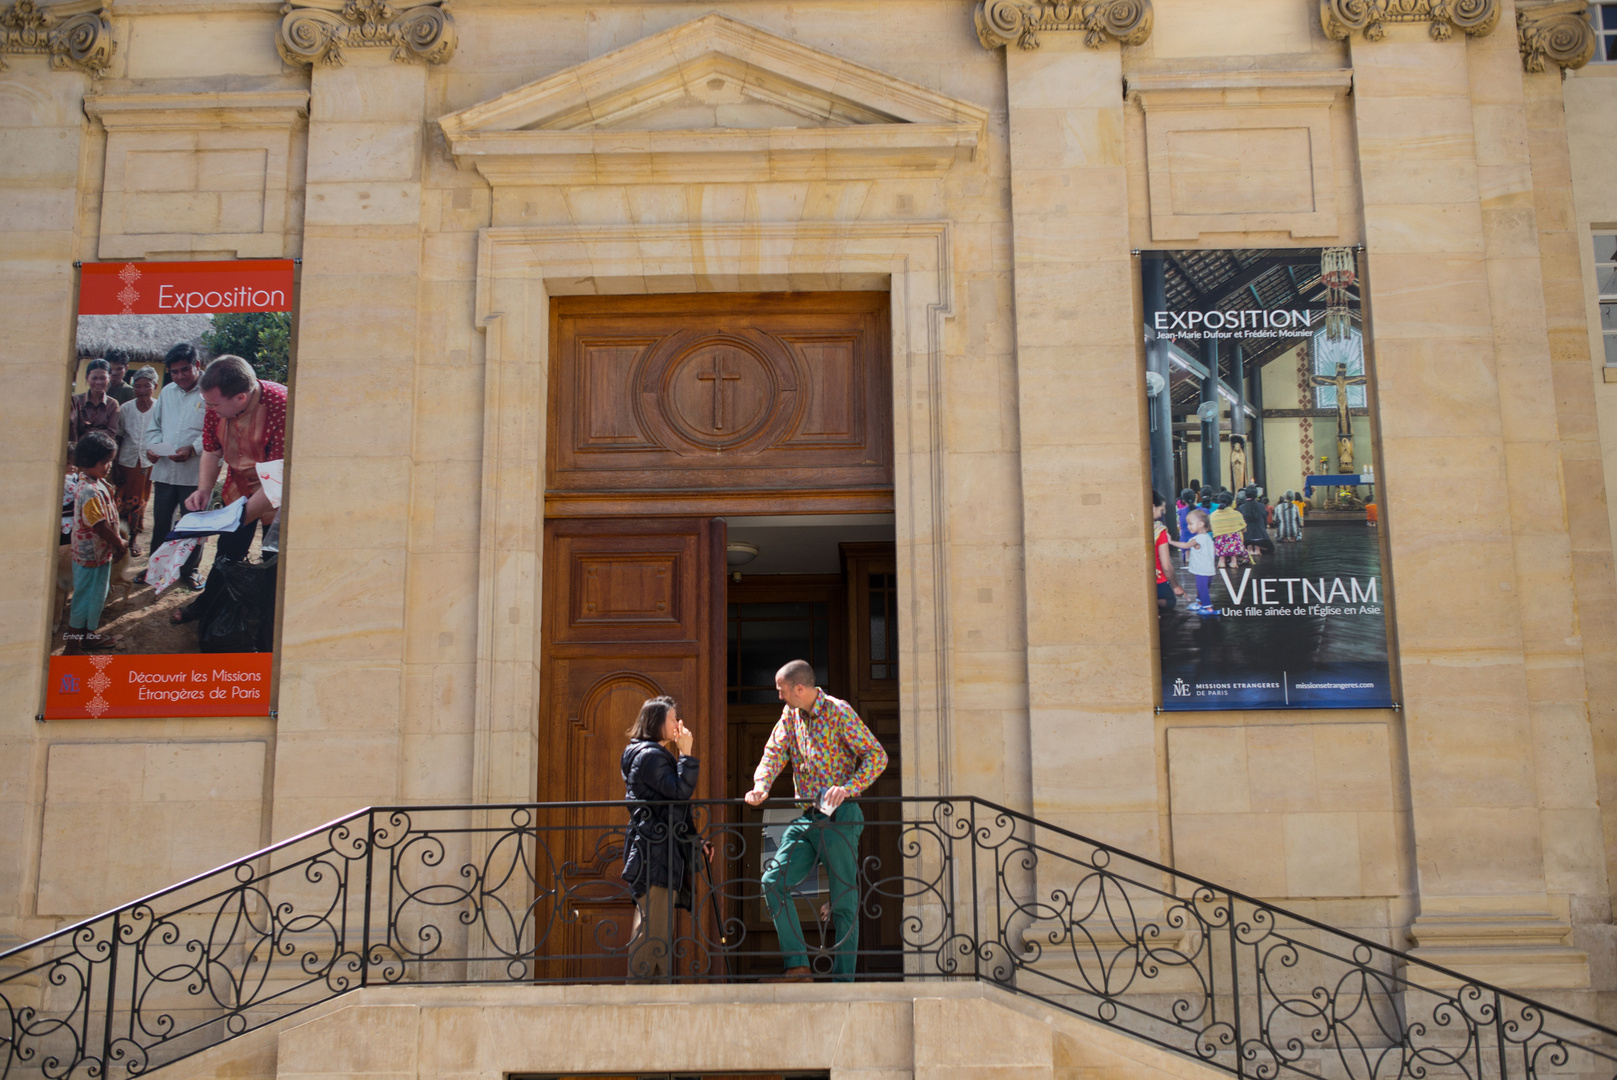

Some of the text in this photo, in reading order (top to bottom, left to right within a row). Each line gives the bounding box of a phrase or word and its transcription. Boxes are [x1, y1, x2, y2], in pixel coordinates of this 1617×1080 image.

[159, 284, 284, 313] Exposition
[1154, 309, 1311, 330] EXPOSITION
[1156, 329, 1313, 339] Jean-Marie Dufour et Frédéric Mounier
[1219, 568, 1378, 605] VIETNAM
[1221, 607, 1243, 617] Une
[1244, 606, 1263, 616] fille
[1264, 606, 1291, 616] aînée
[1293, 605, 1307, 616] de
[1344, 604, 1357, 615] en
[1358, 605, 1381, 615] Asie
[128, 669, 261, 683] Découvrir les Missions
[138, 685, 260, 702] Étrangères de Paris
